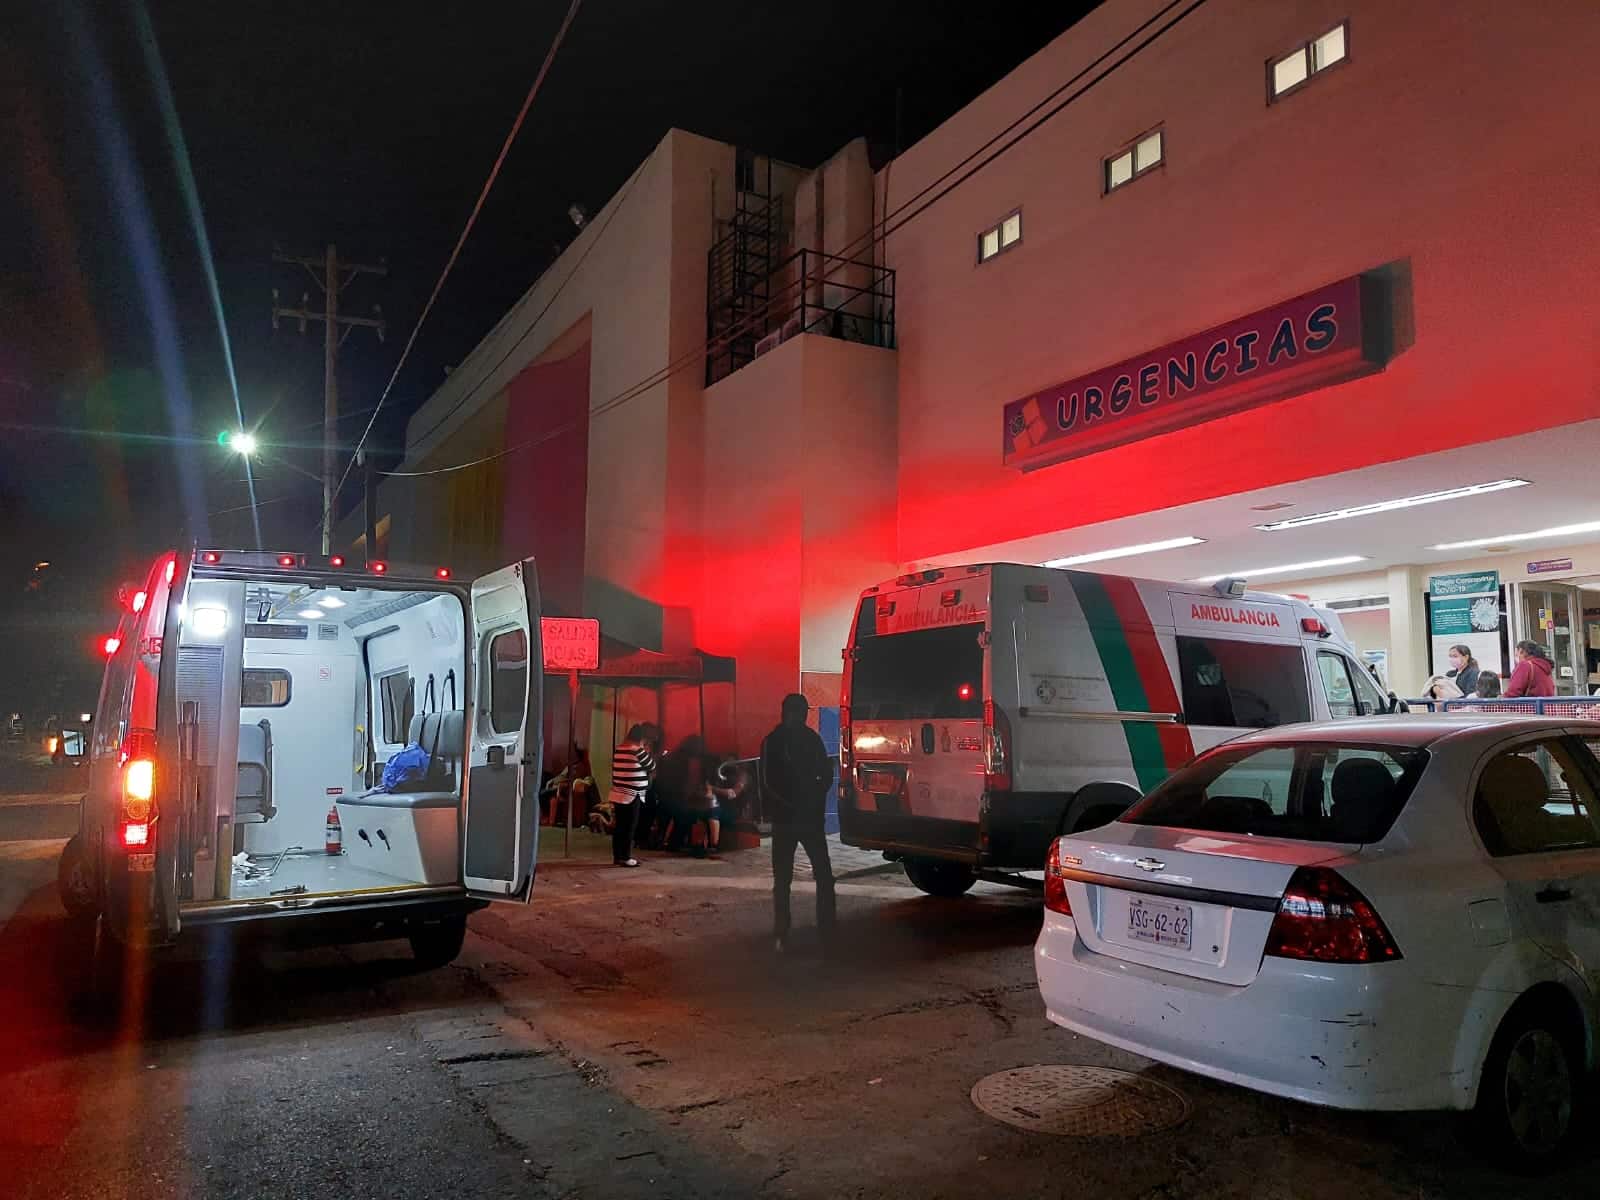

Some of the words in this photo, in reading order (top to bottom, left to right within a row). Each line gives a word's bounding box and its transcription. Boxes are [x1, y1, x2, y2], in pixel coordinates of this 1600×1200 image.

[1056, 303, 1338, 431] URGENCIAS
[1435, 585, 1466, 594] COVID-19
[896, 604, 978, 630] AMBULANCIA
[1191, 603, 1280, 627] AMBULANCIA
[1129, 907, 1188, 936] VSG-62-62
